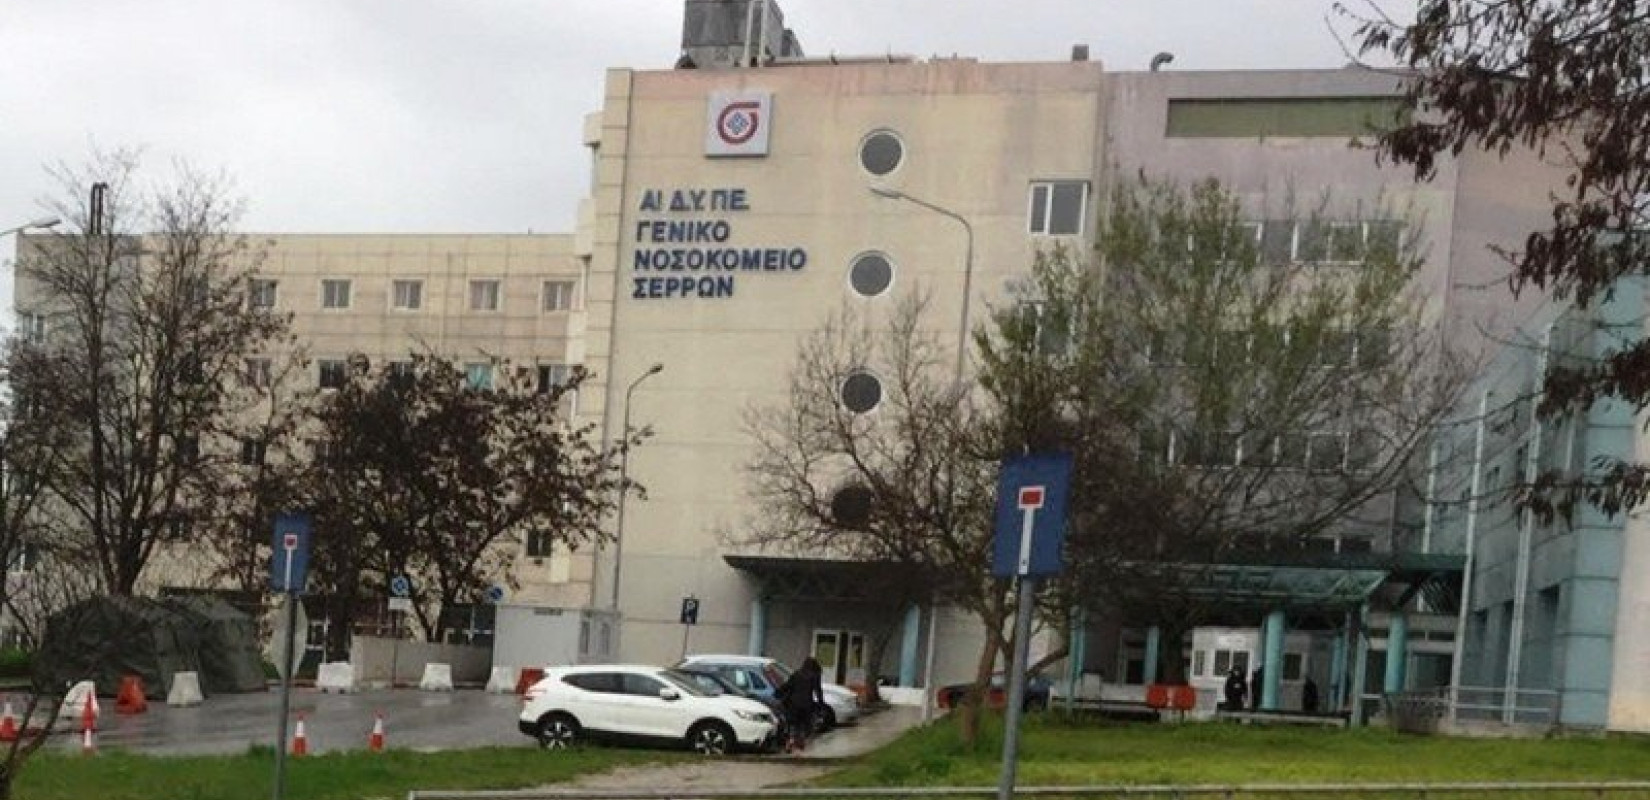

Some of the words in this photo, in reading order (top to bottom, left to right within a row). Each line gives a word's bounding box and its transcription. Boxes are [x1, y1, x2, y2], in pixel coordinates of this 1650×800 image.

[636, 221, 730, 242] ΓΕΝΙΚΟ
[634, 249, 807, 270] ΝΟΣΟΚΟΜΕΙΟ
[632, 276, 733, 299] ΣΕΡΡΩΝ
